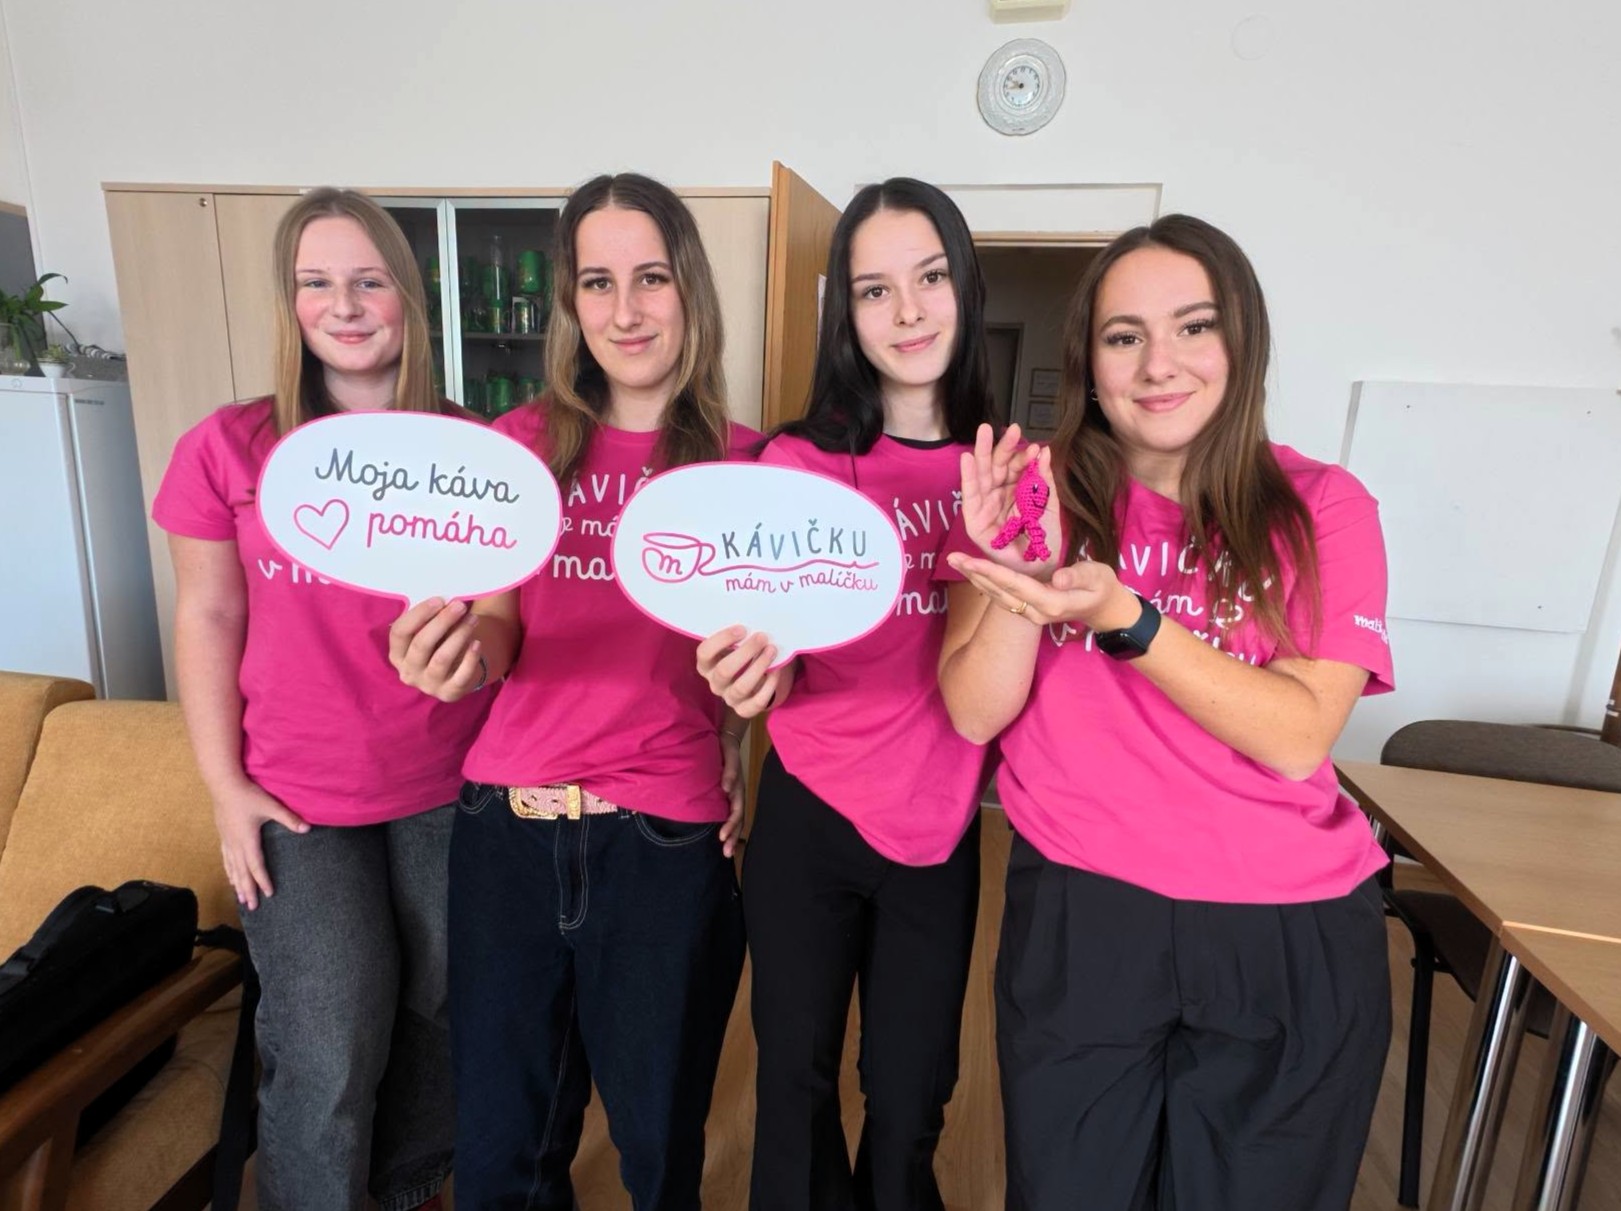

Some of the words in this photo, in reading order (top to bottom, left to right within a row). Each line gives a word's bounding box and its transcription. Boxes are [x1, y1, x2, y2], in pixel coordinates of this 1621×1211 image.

[315, 448, 419, 501] Moja
[428, 463, 520, 504] káva
[366, 511, 517, 549] pomáha
[721, 518, 867, 561] KÁVIČKU
[725, 572, 776, 593] mám
[780, 580, 794, 593] v
[799, 568, 878, 591] malíčku
